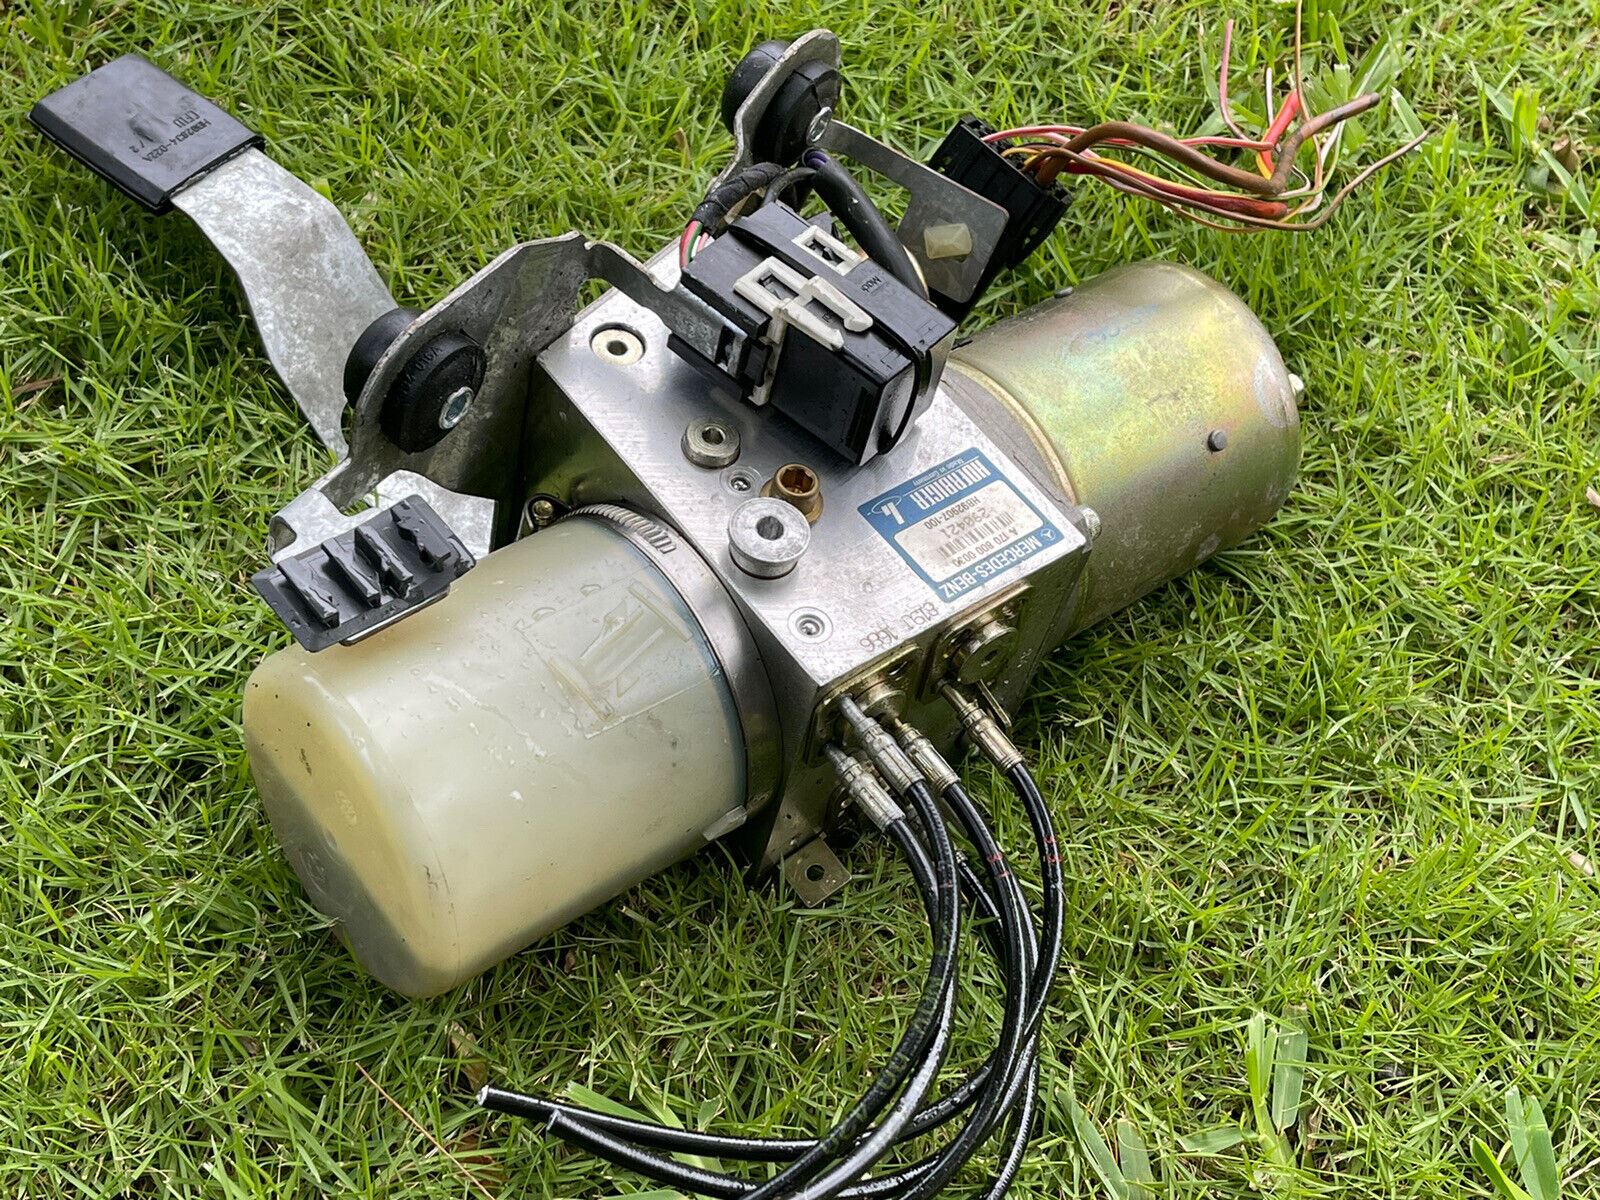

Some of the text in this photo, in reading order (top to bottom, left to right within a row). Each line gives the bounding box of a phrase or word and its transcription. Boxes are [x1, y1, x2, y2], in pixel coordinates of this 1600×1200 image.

[909, 459, 992, 510] HOERBIGER
[924, 496, 981, 530] HB92907-100
[993, 531, 1010, 545] 170
[1009, 526, 1018, 536] A
[975, 541, 995, 556] 800
[938, 534, 1042, 598] MERCEDES-BENZ
